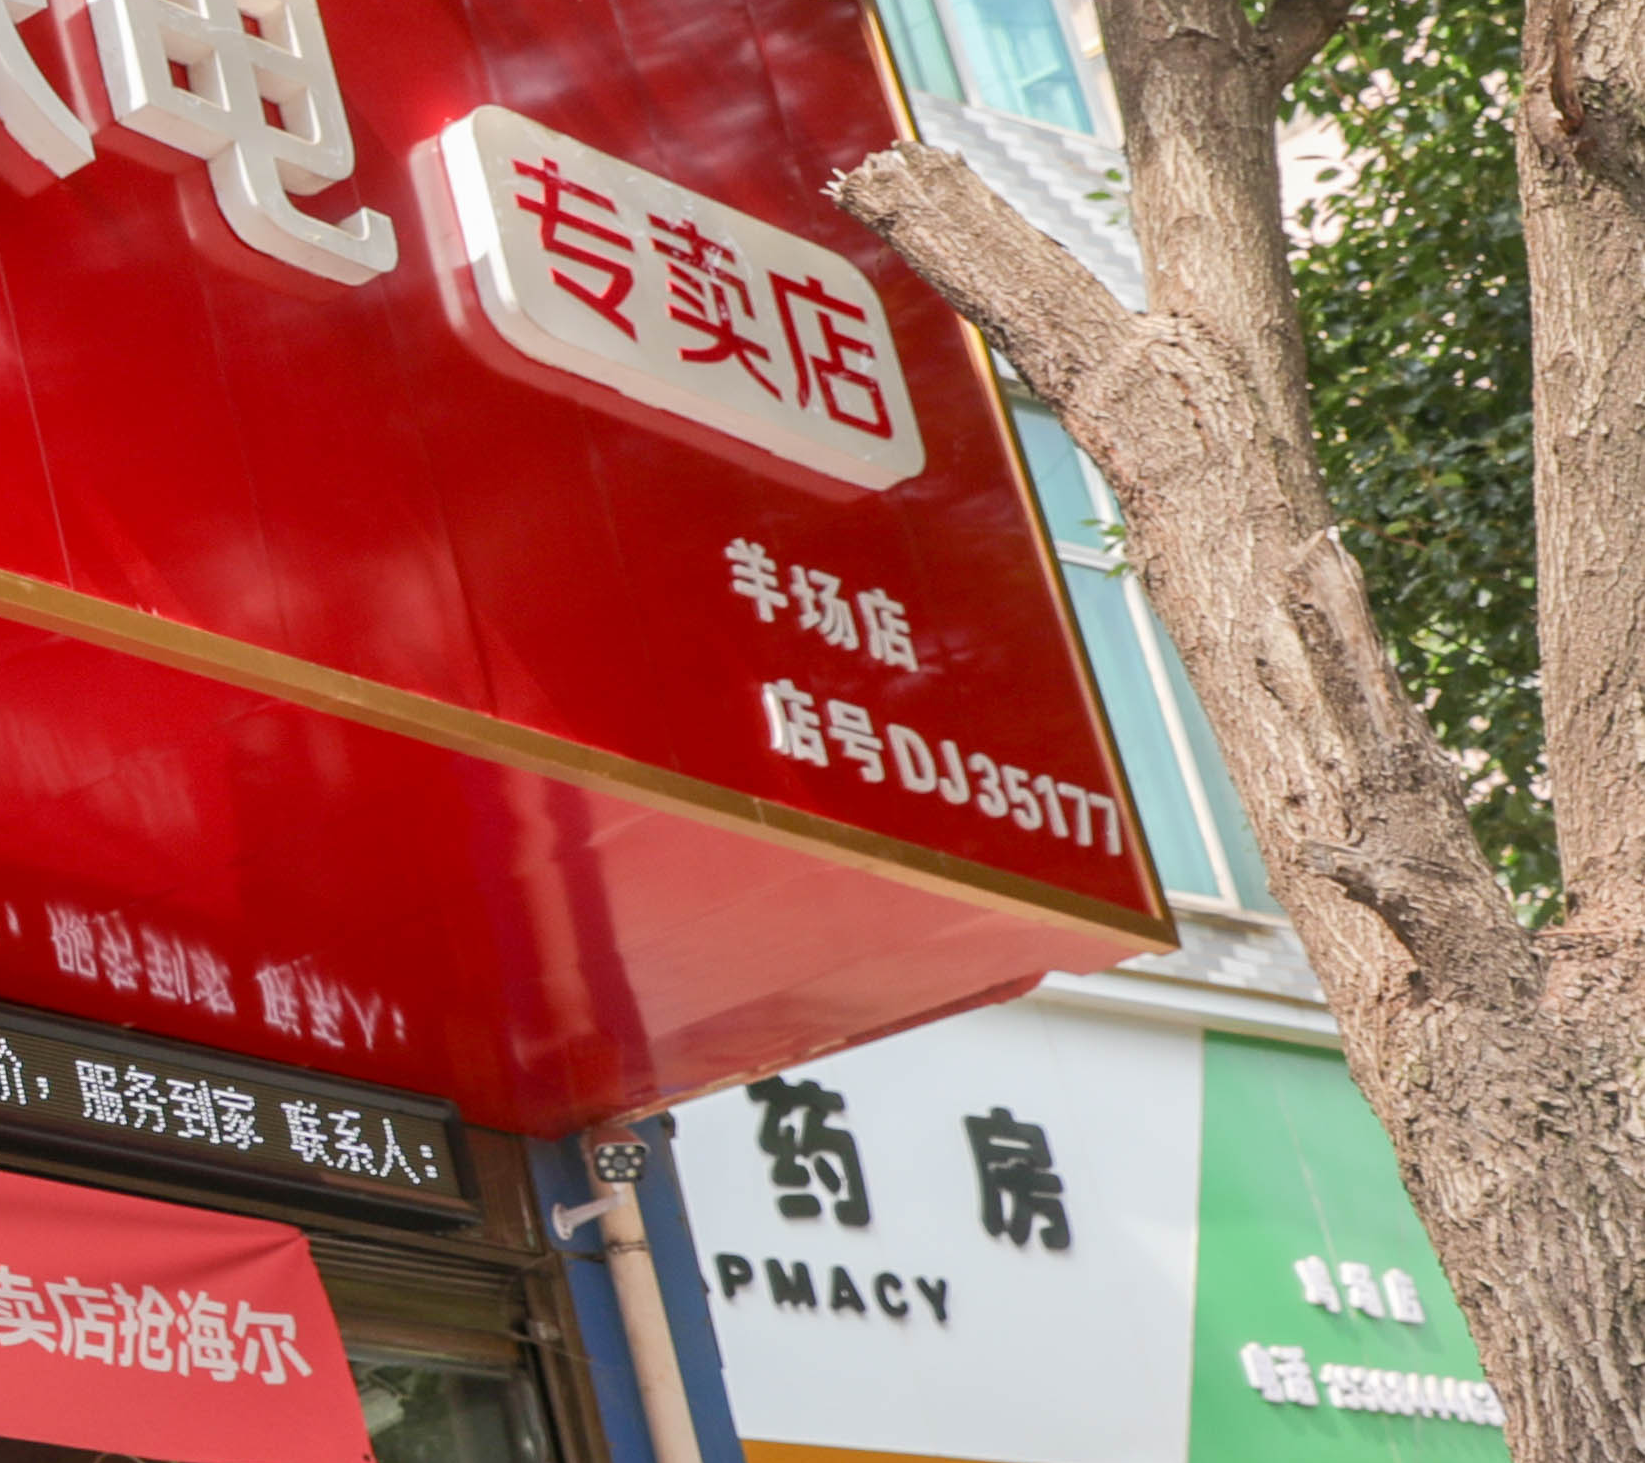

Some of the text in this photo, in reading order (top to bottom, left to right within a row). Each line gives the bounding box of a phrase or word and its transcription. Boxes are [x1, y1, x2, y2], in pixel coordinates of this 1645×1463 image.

[509, 150, 898, 447] 专卖店
[723, 537, 920, 674] 羊场店
[762, 678, 1123, 857] 店号DJ35177
